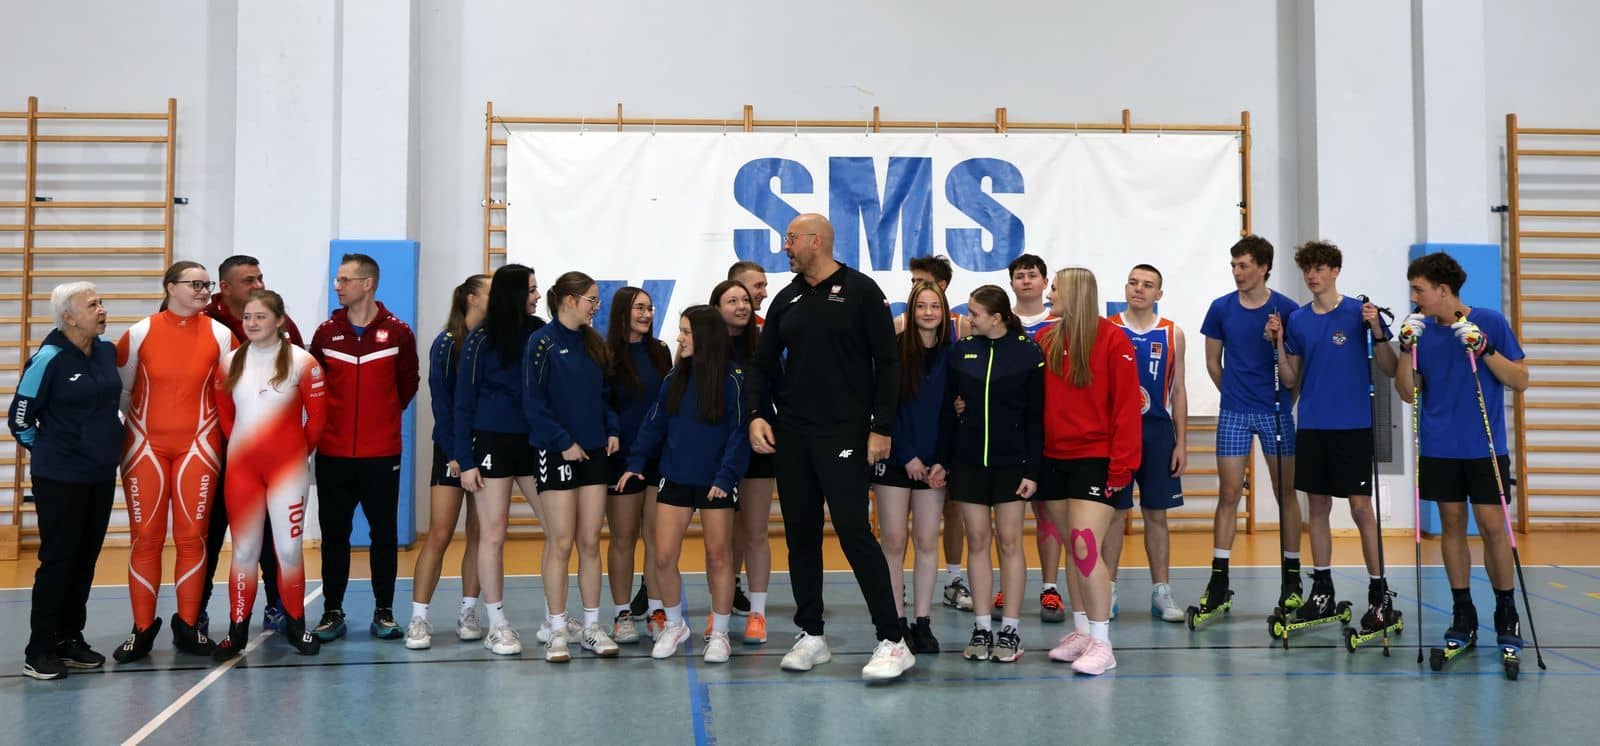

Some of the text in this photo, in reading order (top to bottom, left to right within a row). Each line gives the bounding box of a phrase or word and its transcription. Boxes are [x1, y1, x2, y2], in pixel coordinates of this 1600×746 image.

[733, 156, 1025, 273] SMS
[1149, 360, 1159, 381] 4
[481, 453, 493, 471] 4
[557, 464, 573, 482] 19
[129, 477, 143, 523] POLAND
[196, 474, 210, 520] POLAND
[288, 495, 305, 539] POL
[236, 573, 247, 624] POLSKA
